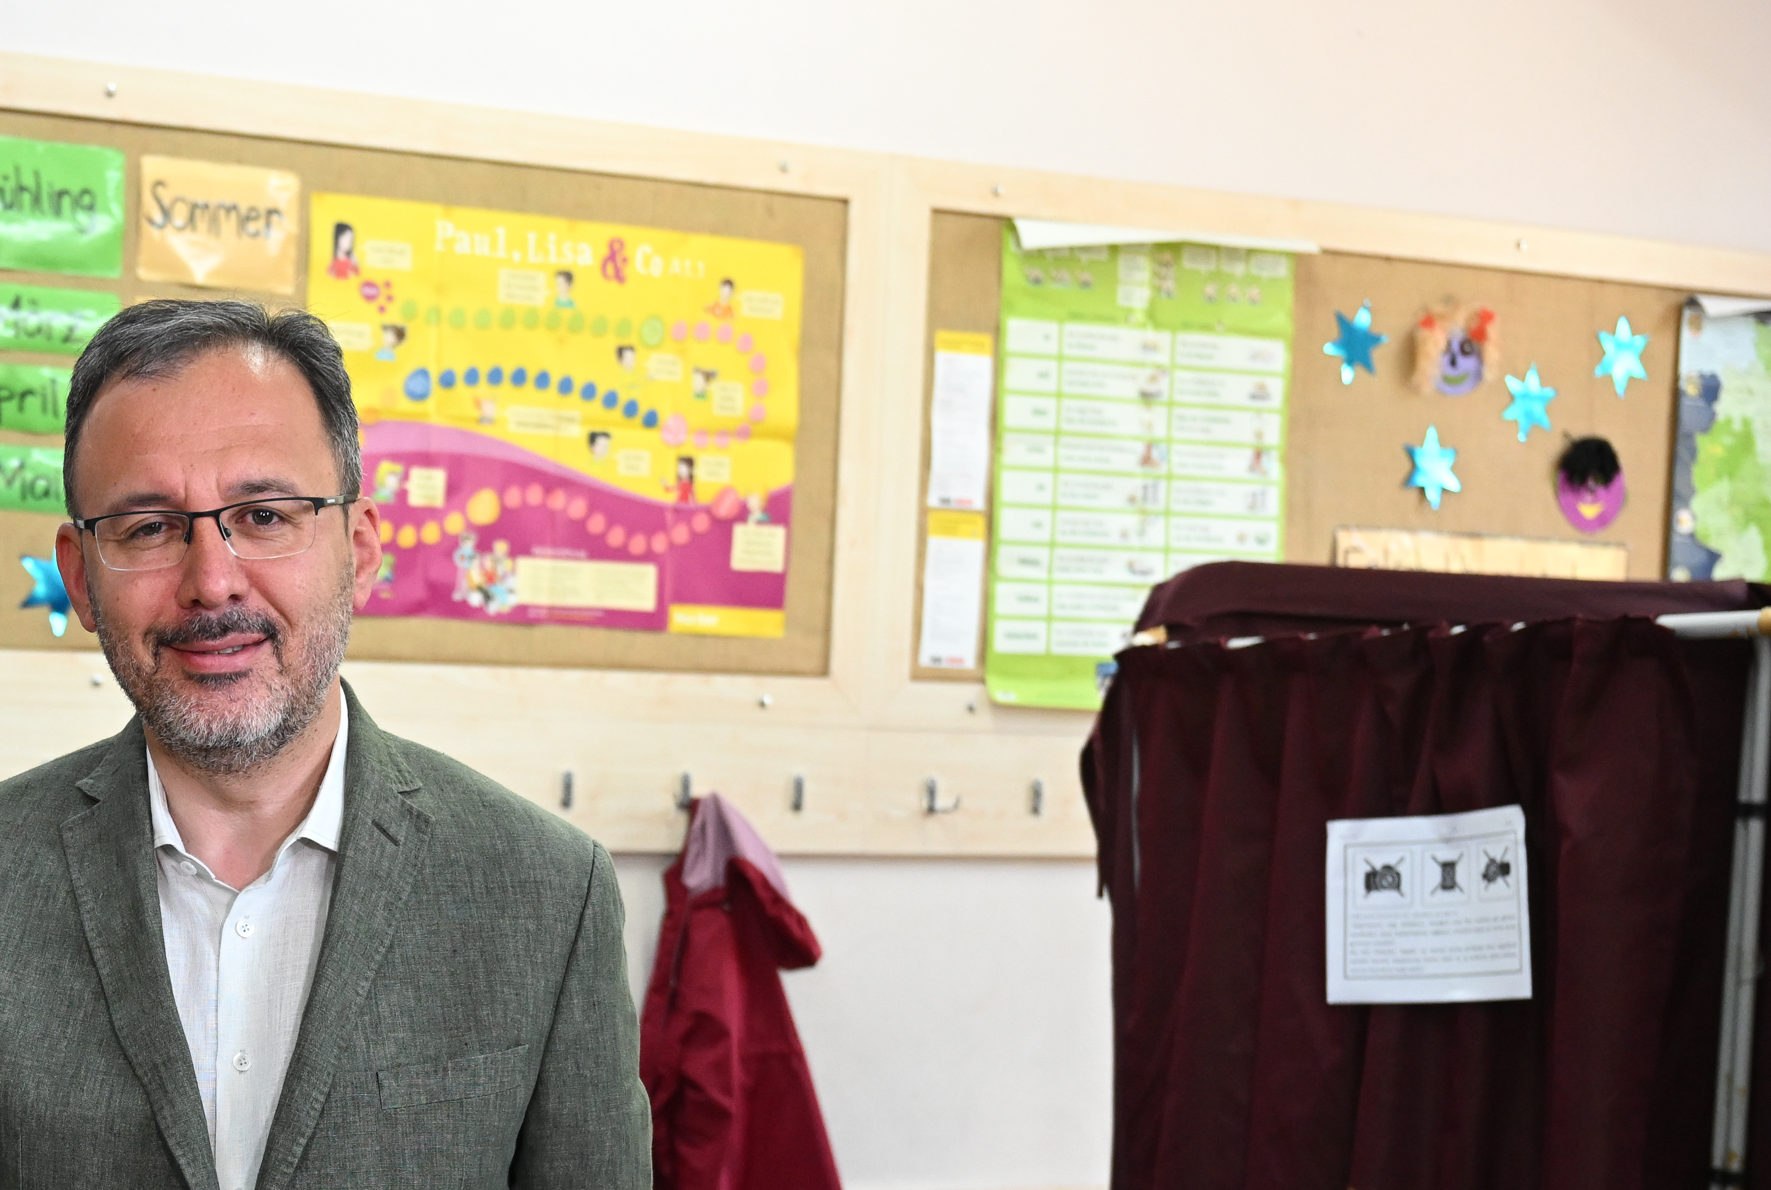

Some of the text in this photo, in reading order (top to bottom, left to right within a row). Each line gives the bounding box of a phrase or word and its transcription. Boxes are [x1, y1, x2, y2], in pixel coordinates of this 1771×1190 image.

[145, 178, 282, 240] Sommer
[527, 231, 595, 267] Lisa
[600, 236, 628, 285] &
[634, 243, 664, 278] Co
